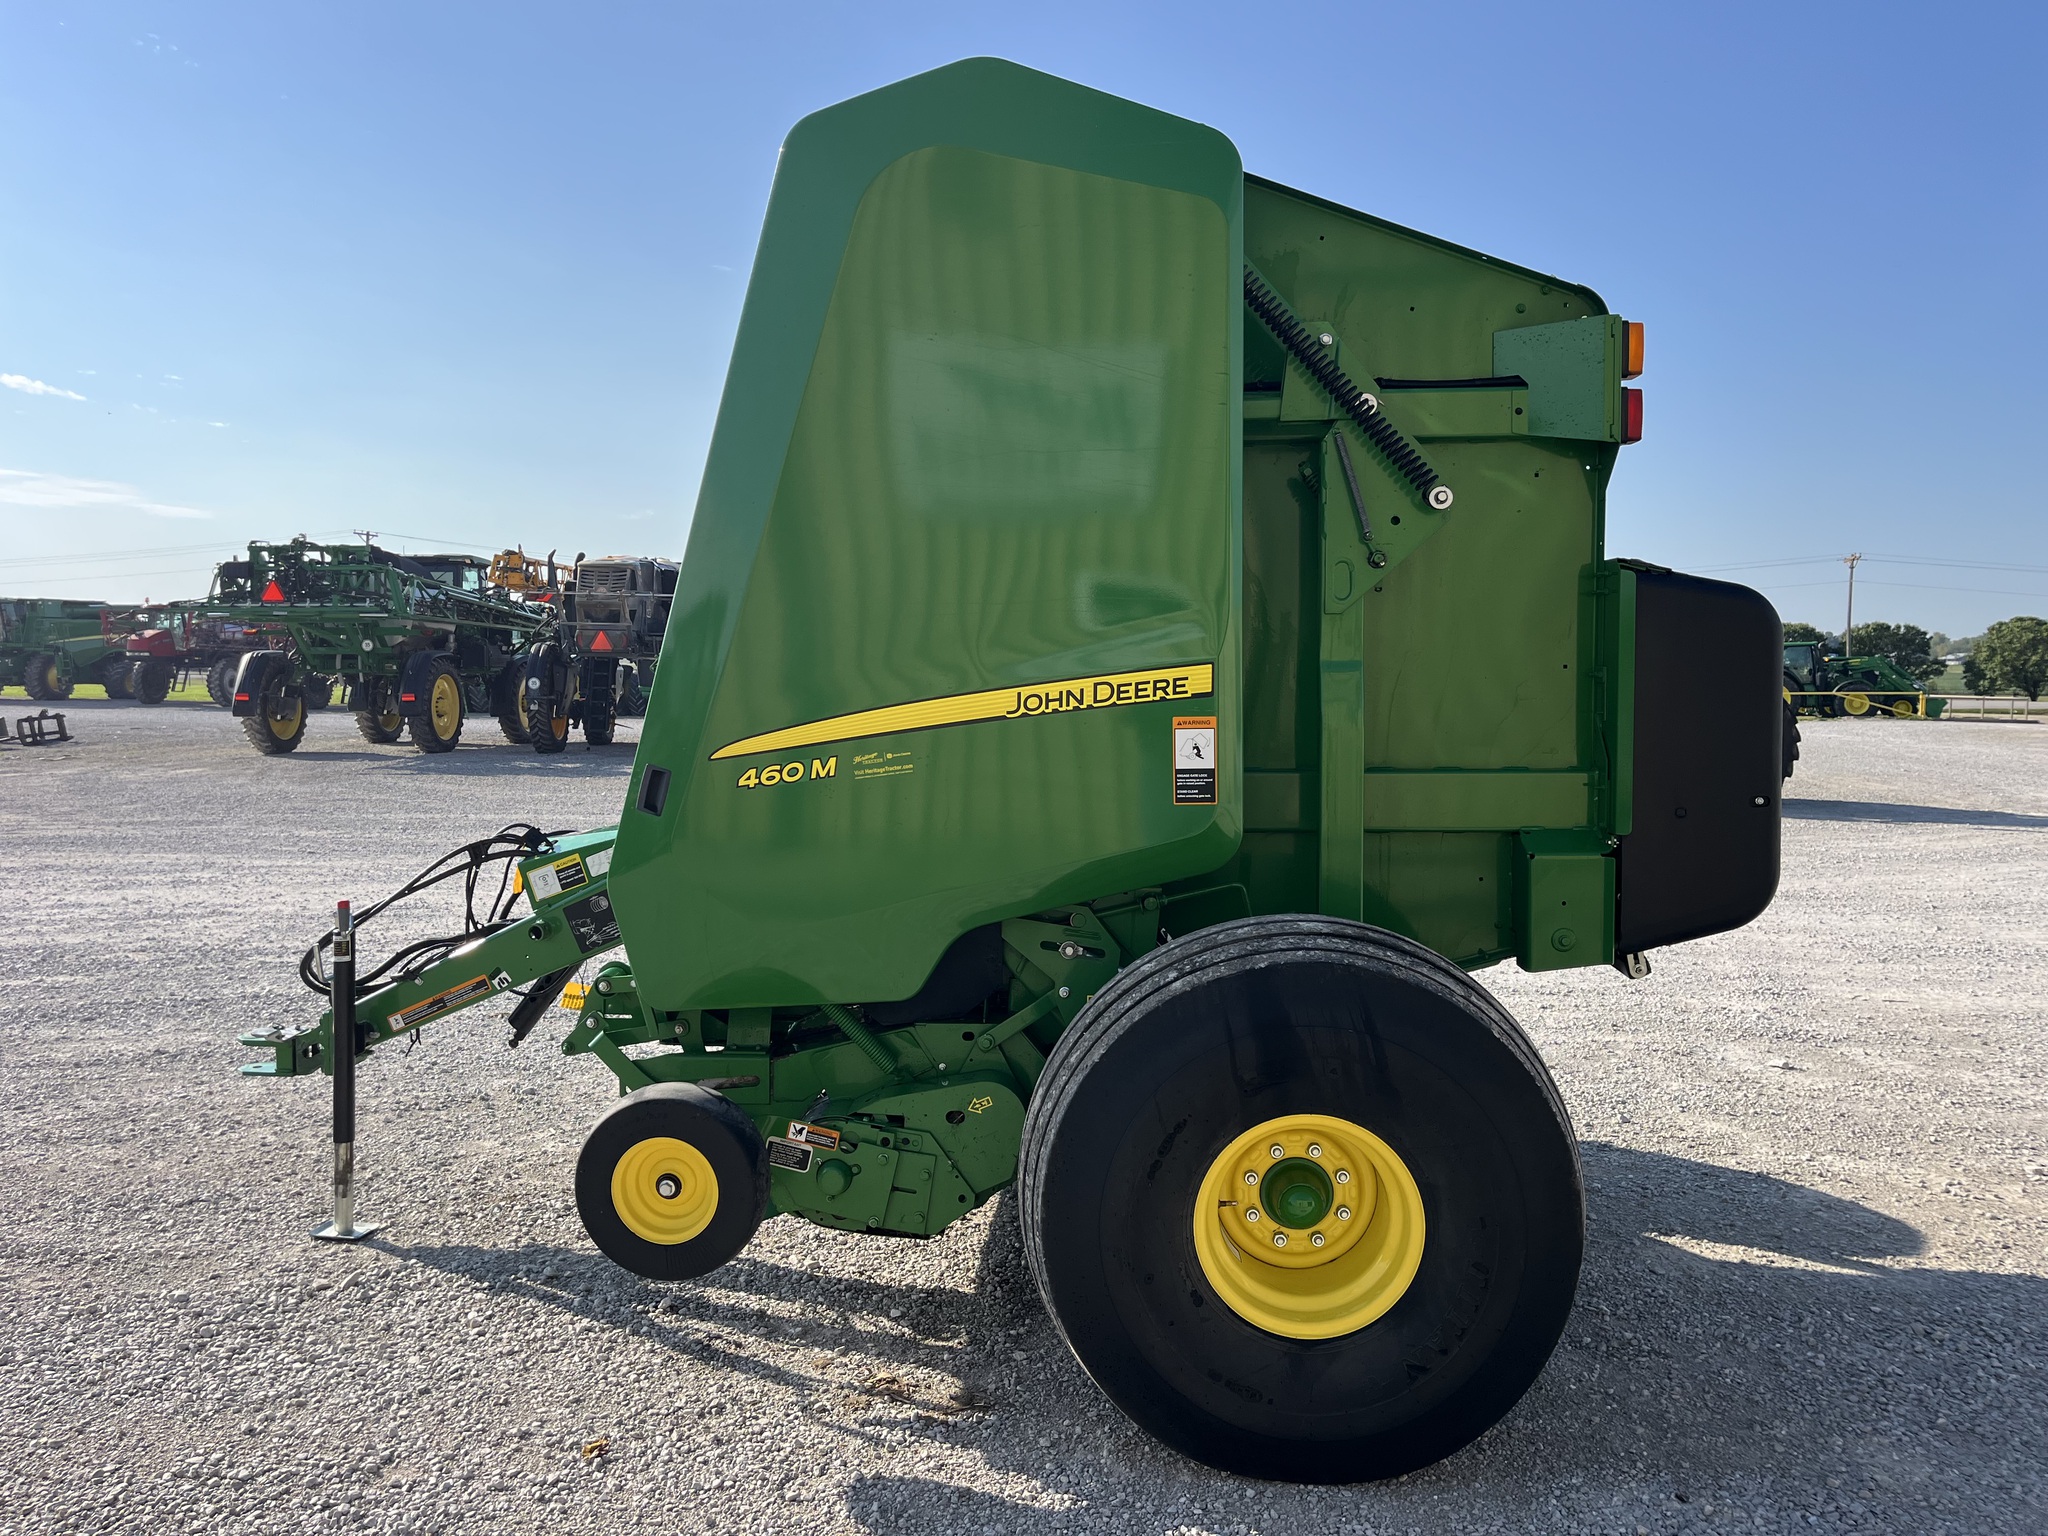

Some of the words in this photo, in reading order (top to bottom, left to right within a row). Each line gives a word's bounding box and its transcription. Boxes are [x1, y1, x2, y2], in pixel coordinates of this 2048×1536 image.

[1005, 688, 1085, 716] JOHN
[1094, 676, 1189, 704] DEERE
[736, 761, 806, 790] 460
[810, 755, 838, 780] M
[560, 858, 577, 866] CAUTION
